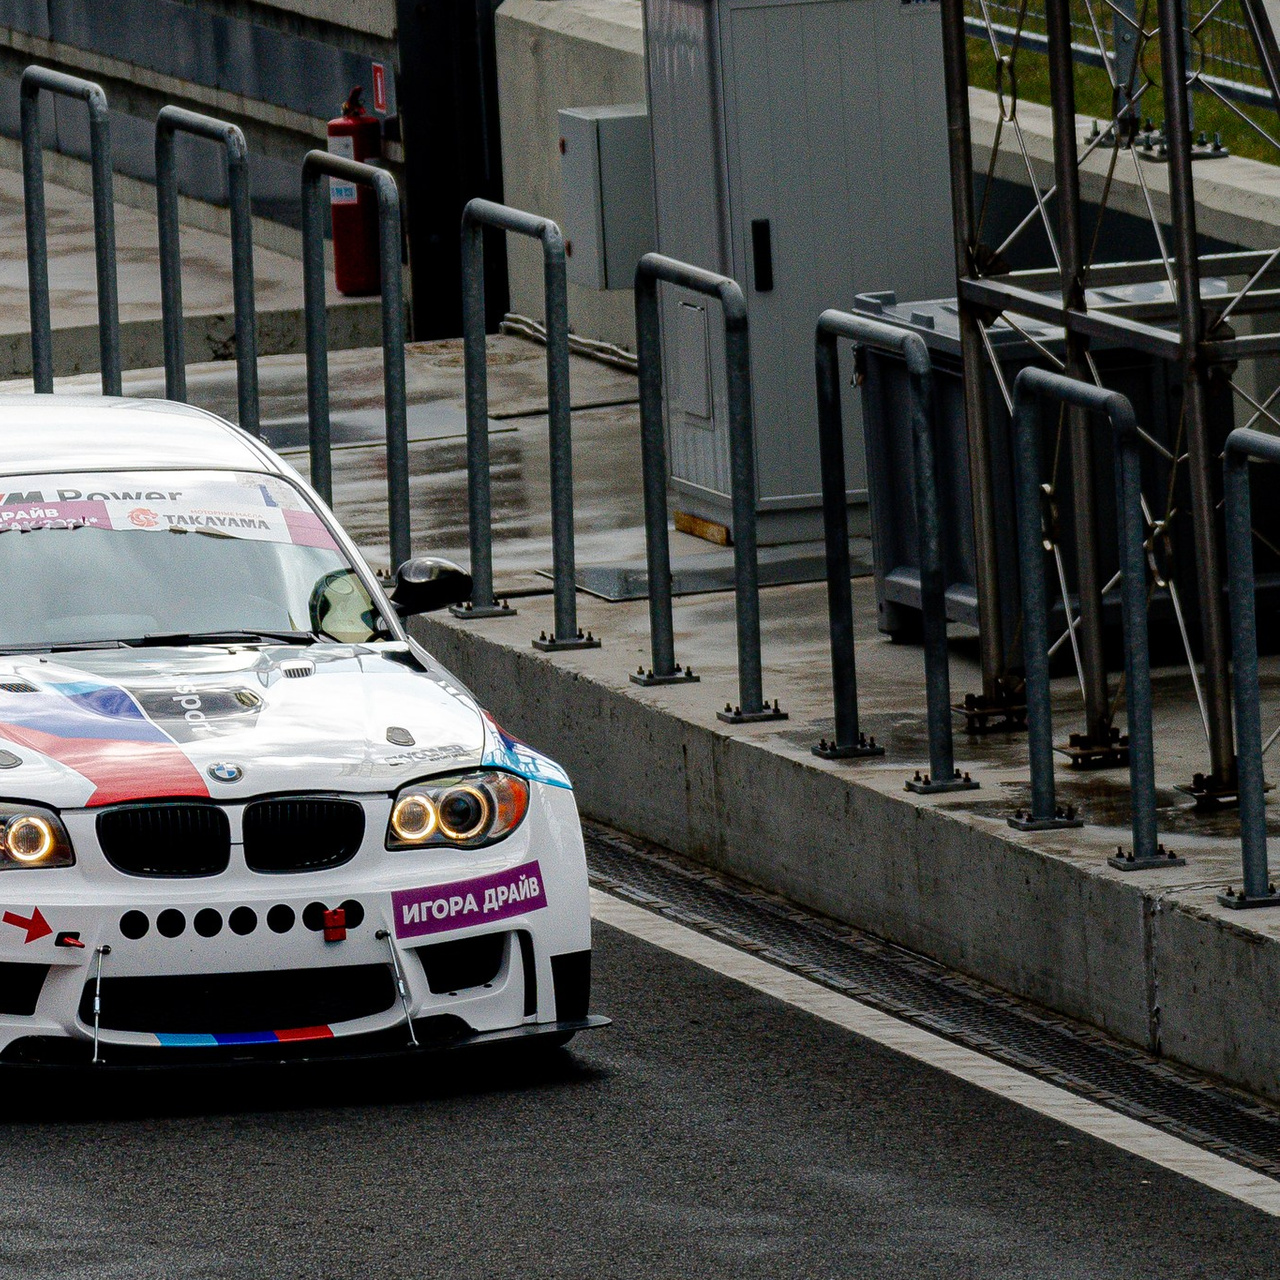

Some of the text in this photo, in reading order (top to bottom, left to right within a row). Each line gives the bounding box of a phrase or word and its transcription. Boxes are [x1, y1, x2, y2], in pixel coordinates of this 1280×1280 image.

[163, 513, 271, 531] TAKAYAMA
[402, 874, 540, 925] ИГОРА ДРАЙВ
